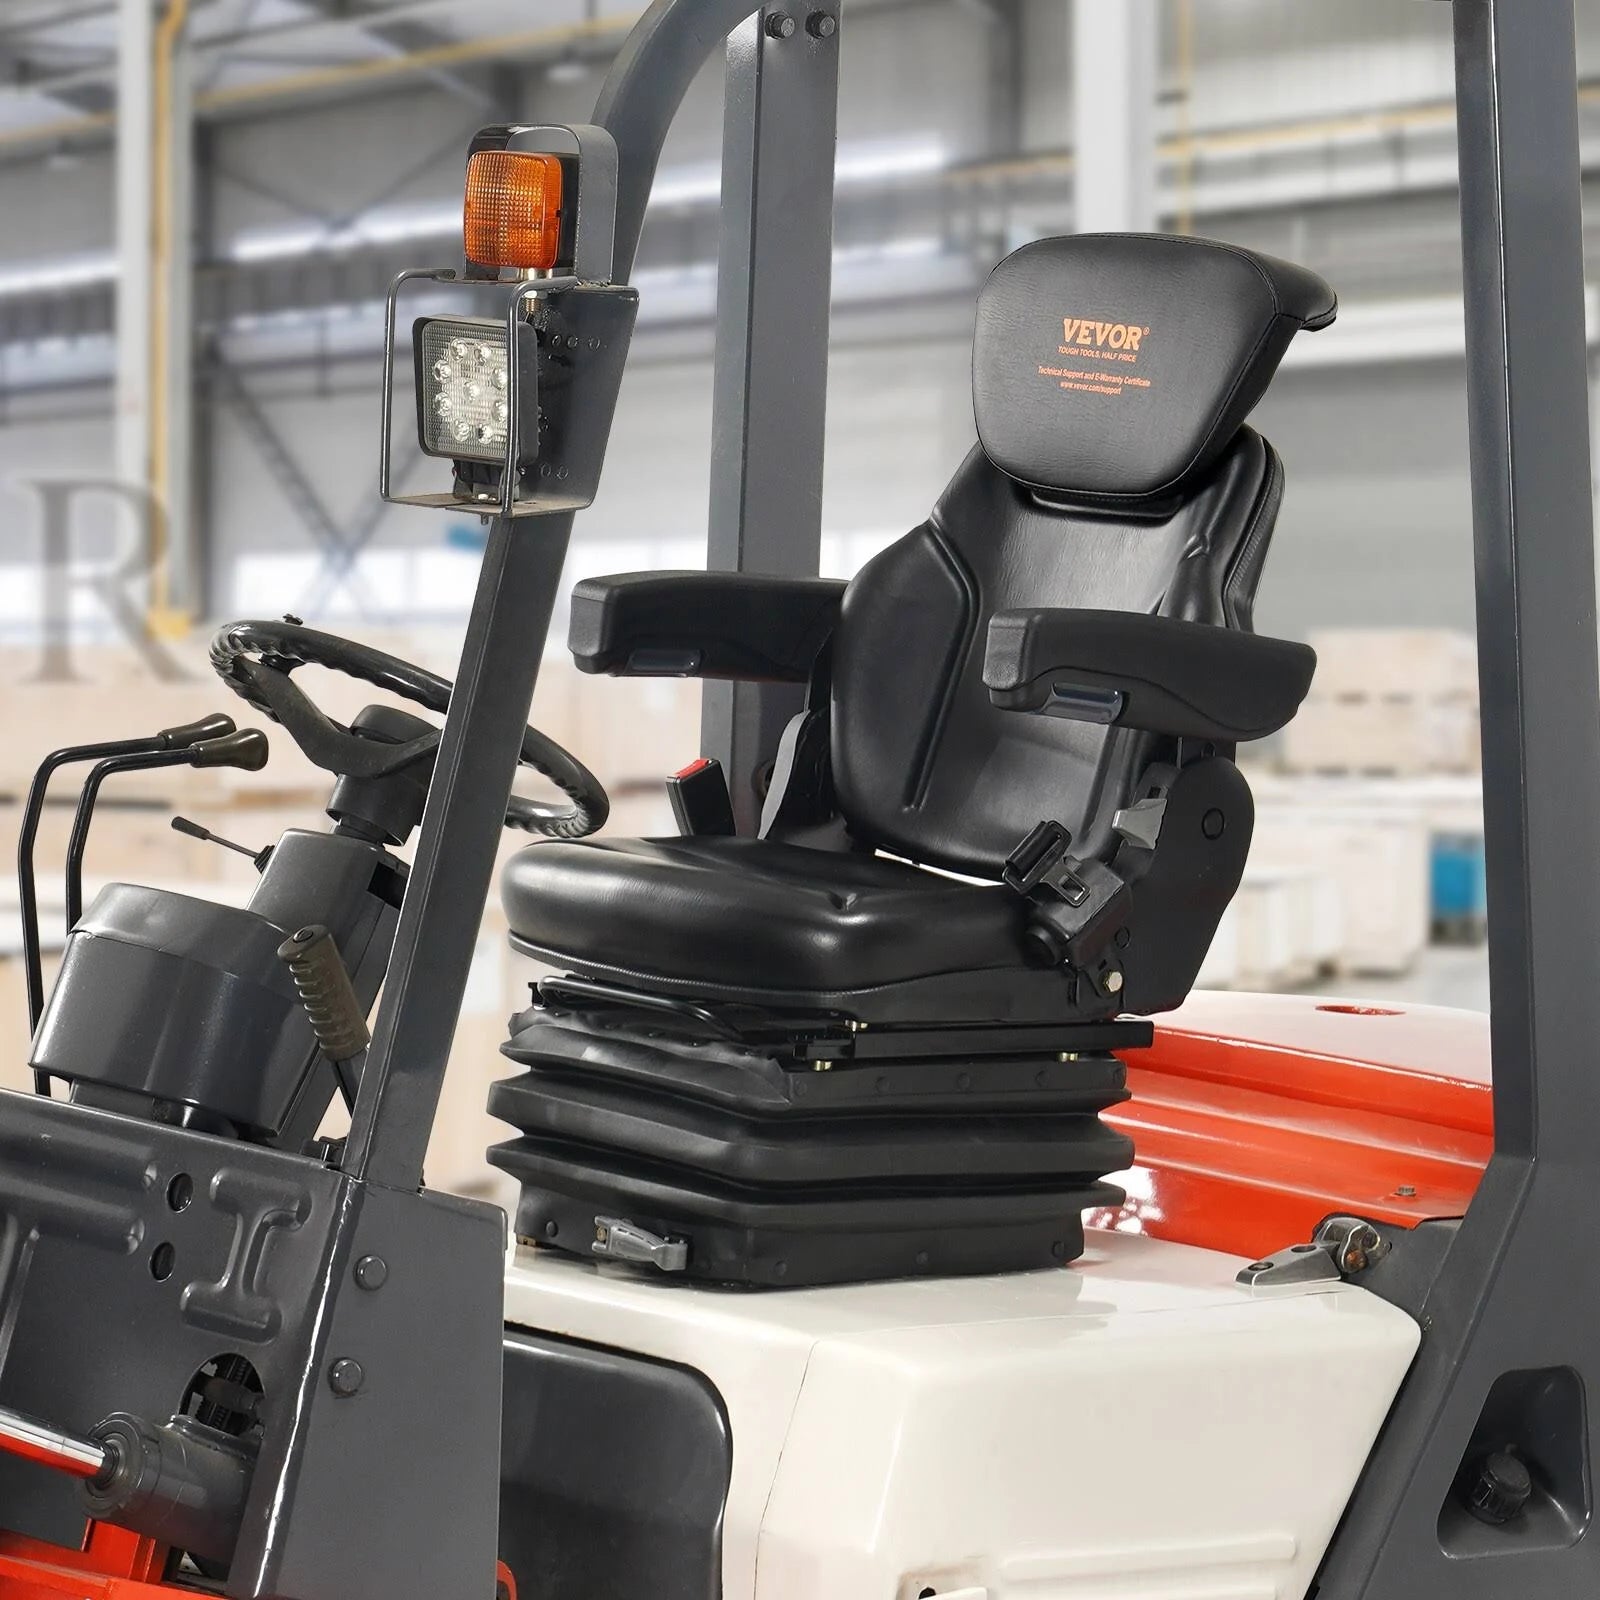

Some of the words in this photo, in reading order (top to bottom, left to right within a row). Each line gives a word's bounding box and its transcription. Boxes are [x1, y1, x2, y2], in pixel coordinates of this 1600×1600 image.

[1058, 346, 1080, 356] TOUGH
[1101, 351, 1117, 360] HALF
[1118, 353, 1137, 363] PRICE
[1038, 366, 1062, 377] Technical
[1062, 369, 1084, 379] Support
[1084, 372, 1095, 380] and
[1095, 373, 1124, 385] E-Warranty
[1124, 376, 1151, 387] Certificate
[1060, 381, 1122, 395] www.vevor.com/support
